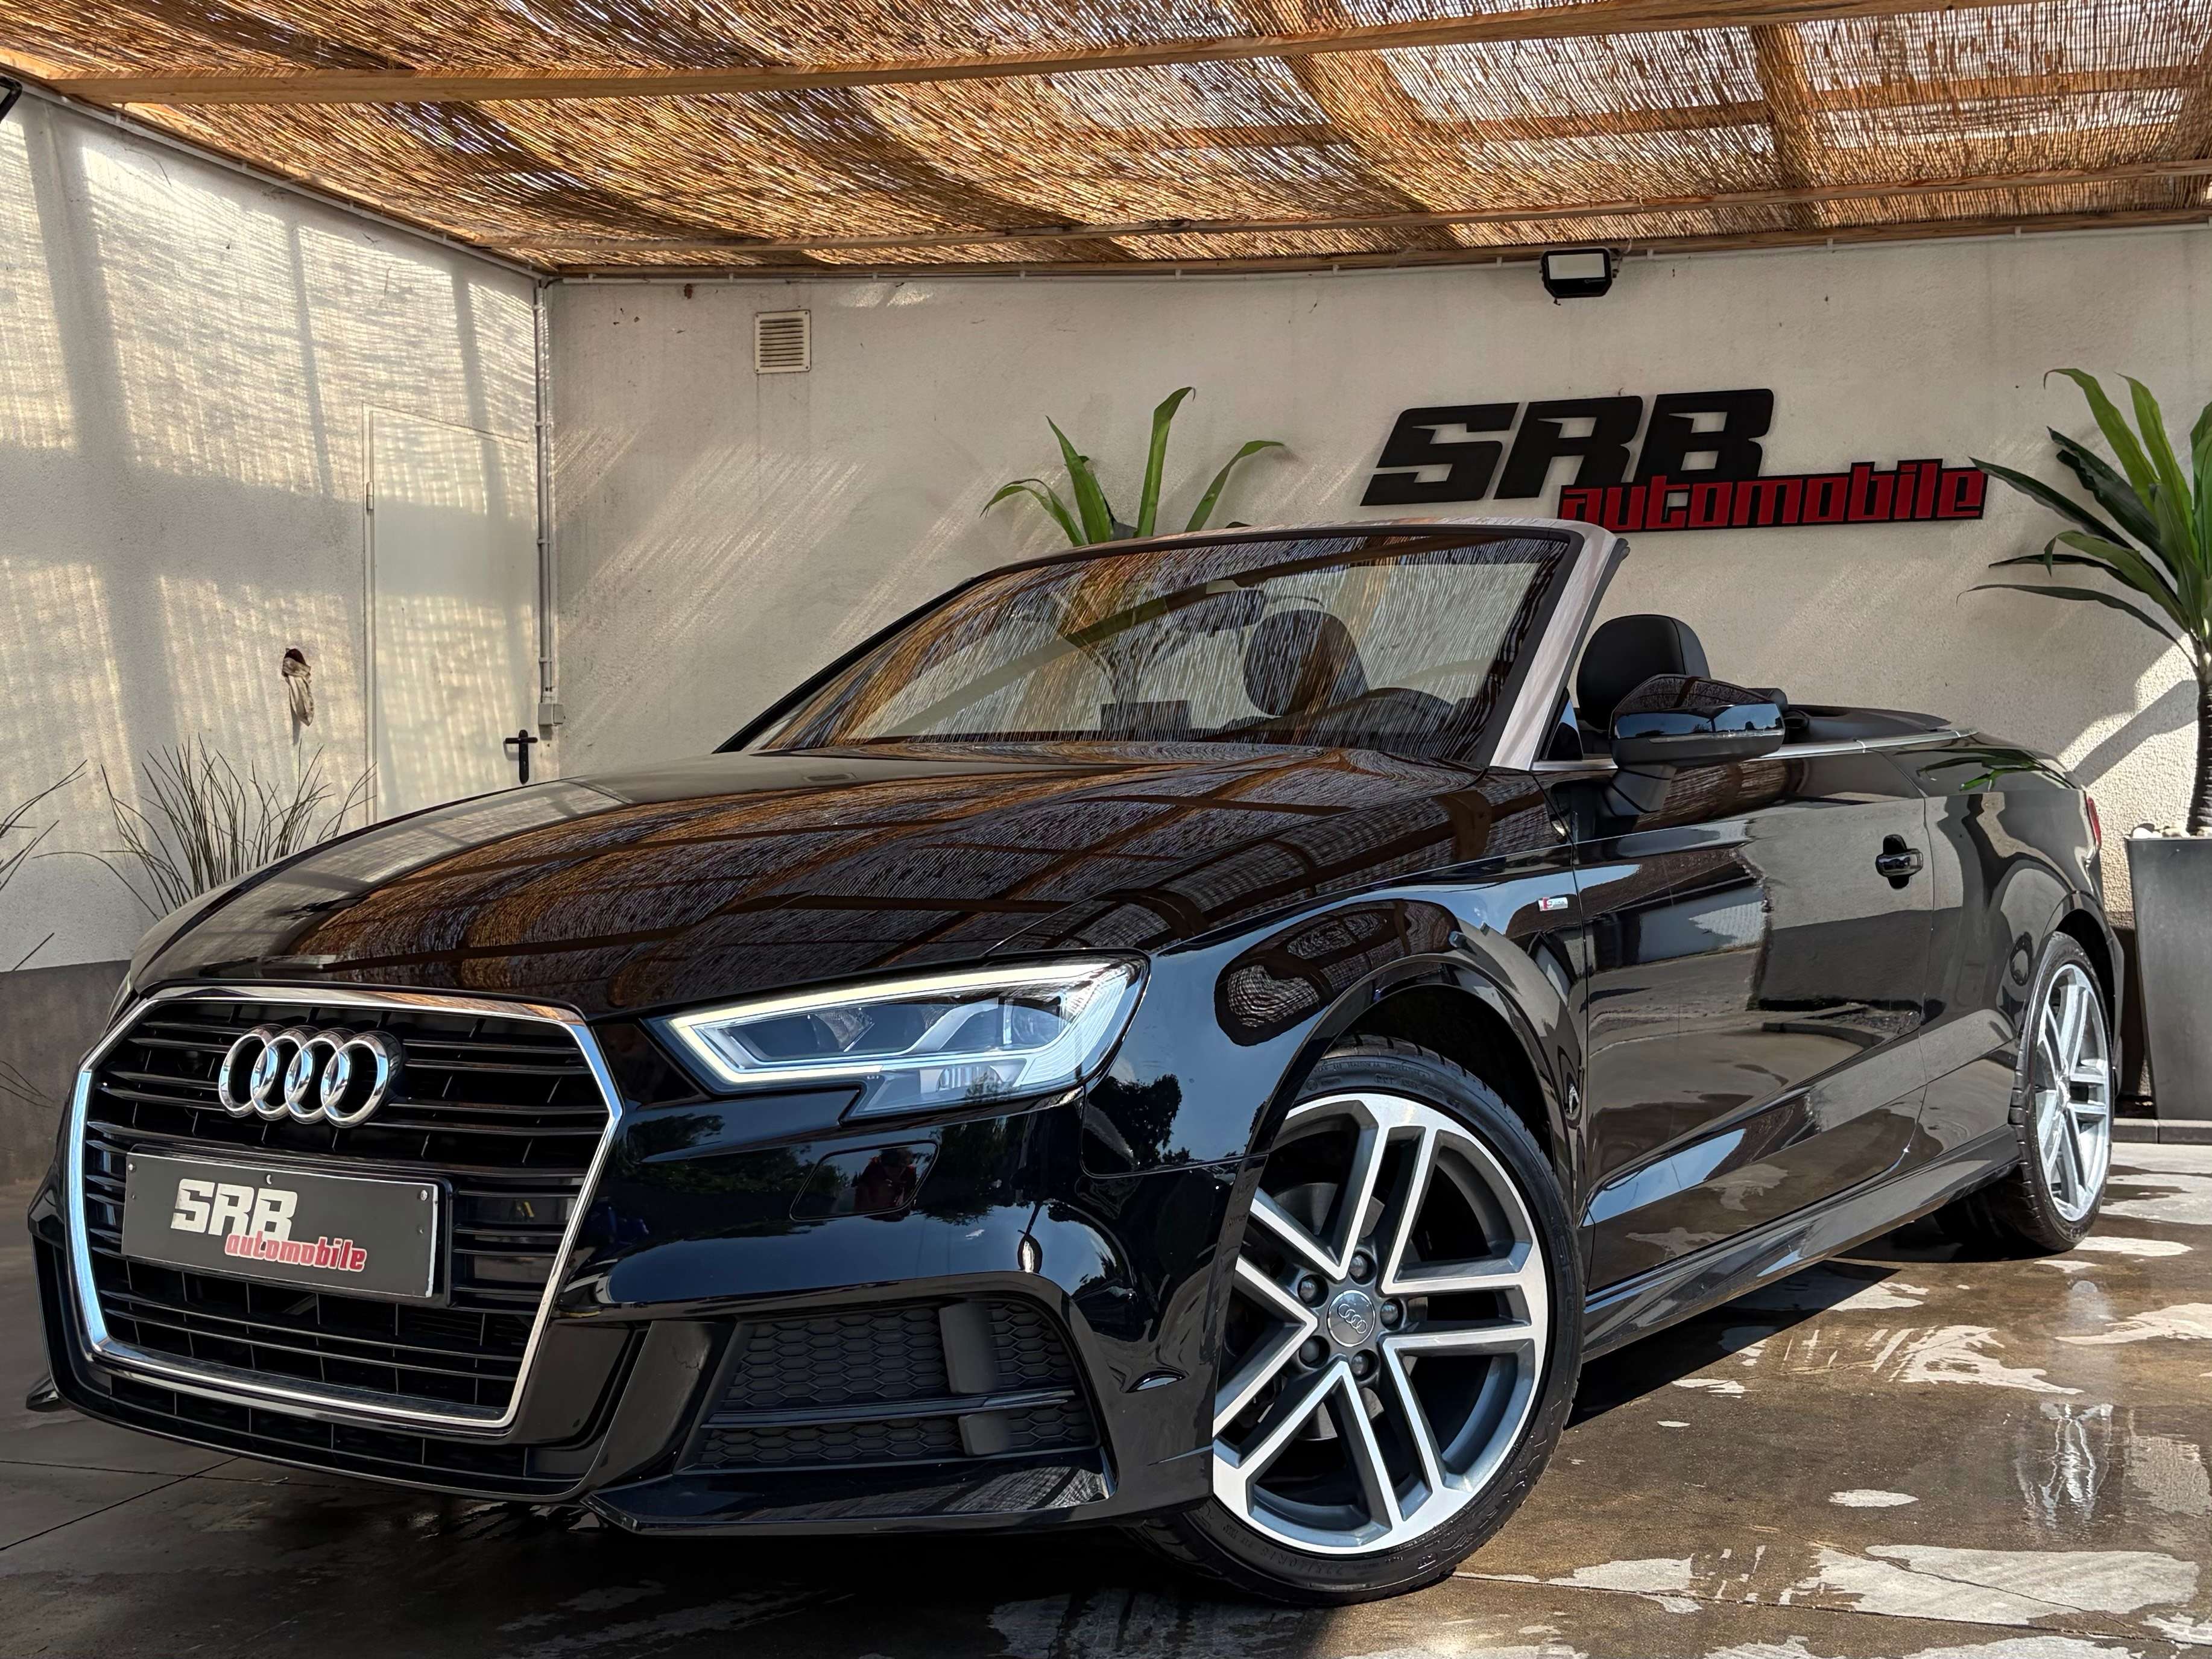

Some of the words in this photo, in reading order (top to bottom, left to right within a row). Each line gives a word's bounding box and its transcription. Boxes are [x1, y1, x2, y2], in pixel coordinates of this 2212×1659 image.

[1359, 388, 1774, 507] SRB
[1558, 460, 1988, 532] automobile
[171, 1178, 298, 1242] SRB
[224, 1230, 367, 1272] automobile
